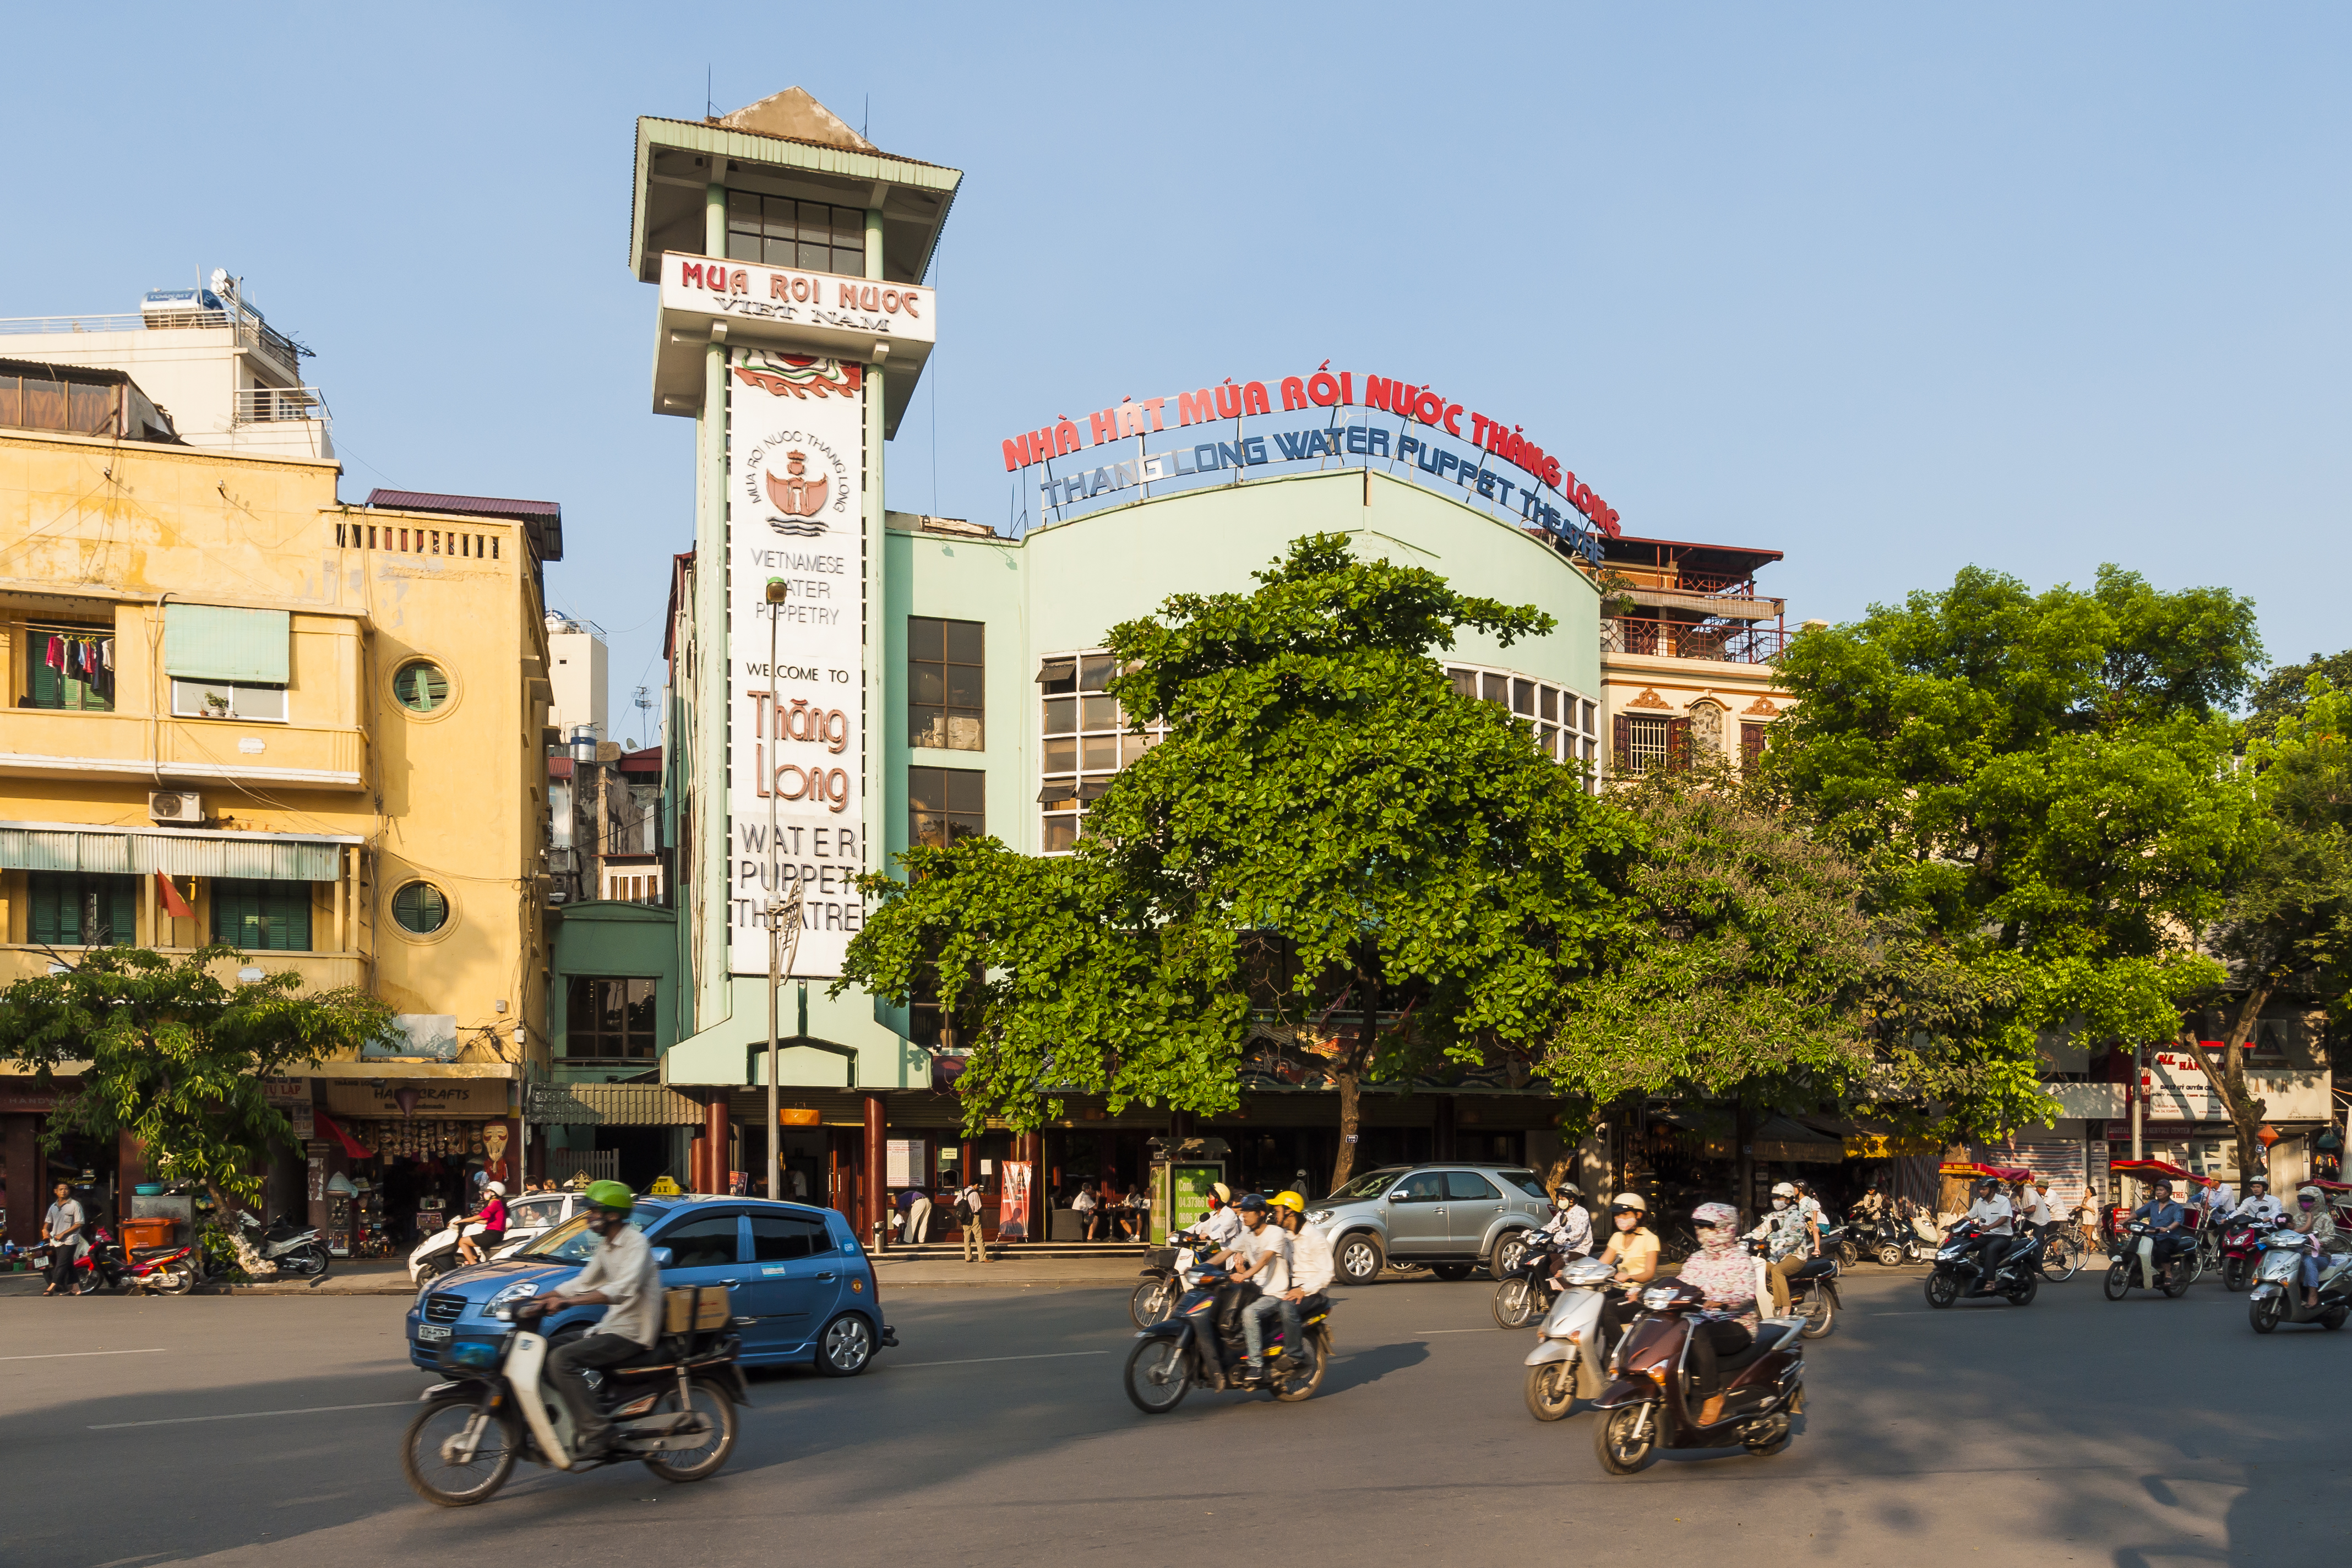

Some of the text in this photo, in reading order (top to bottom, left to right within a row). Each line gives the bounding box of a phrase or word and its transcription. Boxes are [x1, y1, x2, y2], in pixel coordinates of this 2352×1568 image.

[682, 262, 748, 296] MUA
[770, 274, 819, 303] ROI
[714, 297, 891, 332] VIET NAM
[1001, 358, 1621, 540] NHÀ HÁT MÚA RỐI NƯỚC THĂNG LONG
[745, 431, 850, 513] MUA ROI NUOC THANG LONG
[1040, 426, 1605, 570] THANG LONG WATER PUPPET THEATRE
[750, 548, 845, 574] VIETNAMESE
[765, 576, 830, 598] ATER
[756, 602, 839, 625] PUPPETRY
[747, 662, 849, 683] WECOME TO
[747, 690, 847, 754] Thăng
[756, 743, 848, 812] Long
[740, 823, 855, 857] WATER
[740, 860, 854, 894] PUPPET
[374, 1088, 470, 1100] HACRAFTS
